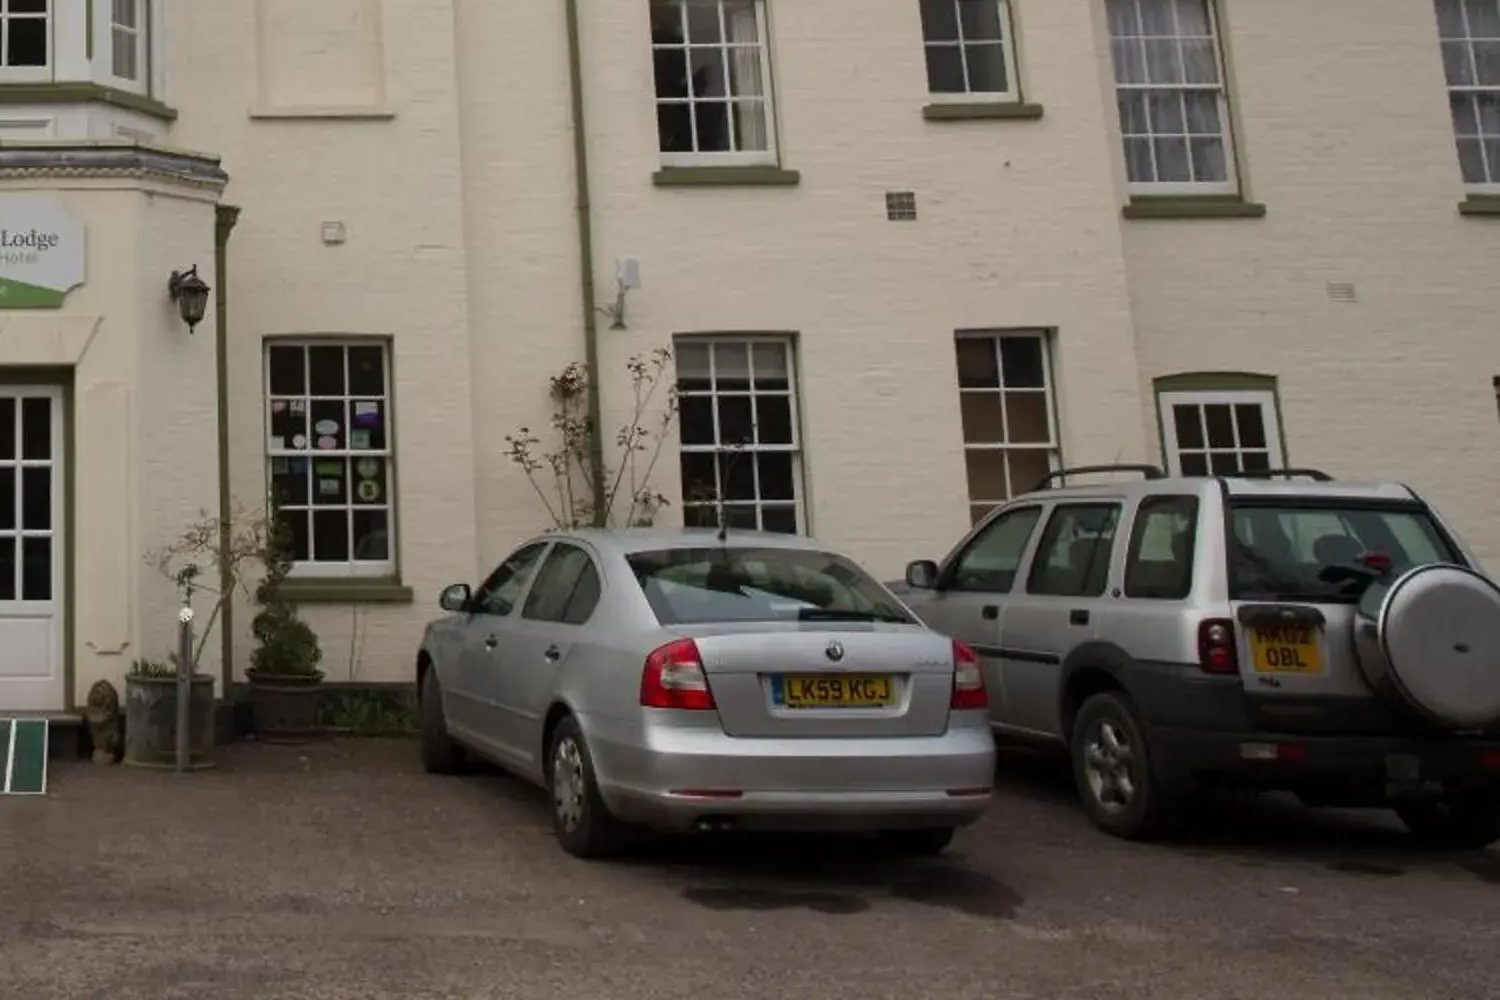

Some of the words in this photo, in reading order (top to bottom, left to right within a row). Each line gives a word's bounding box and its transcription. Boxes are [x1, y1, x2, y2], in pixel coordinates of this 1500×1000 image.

[1, 230, 59, 250] Lodge
[787, 679, 843, 700] LK59
[848, 679, 890, 700] KGJ
